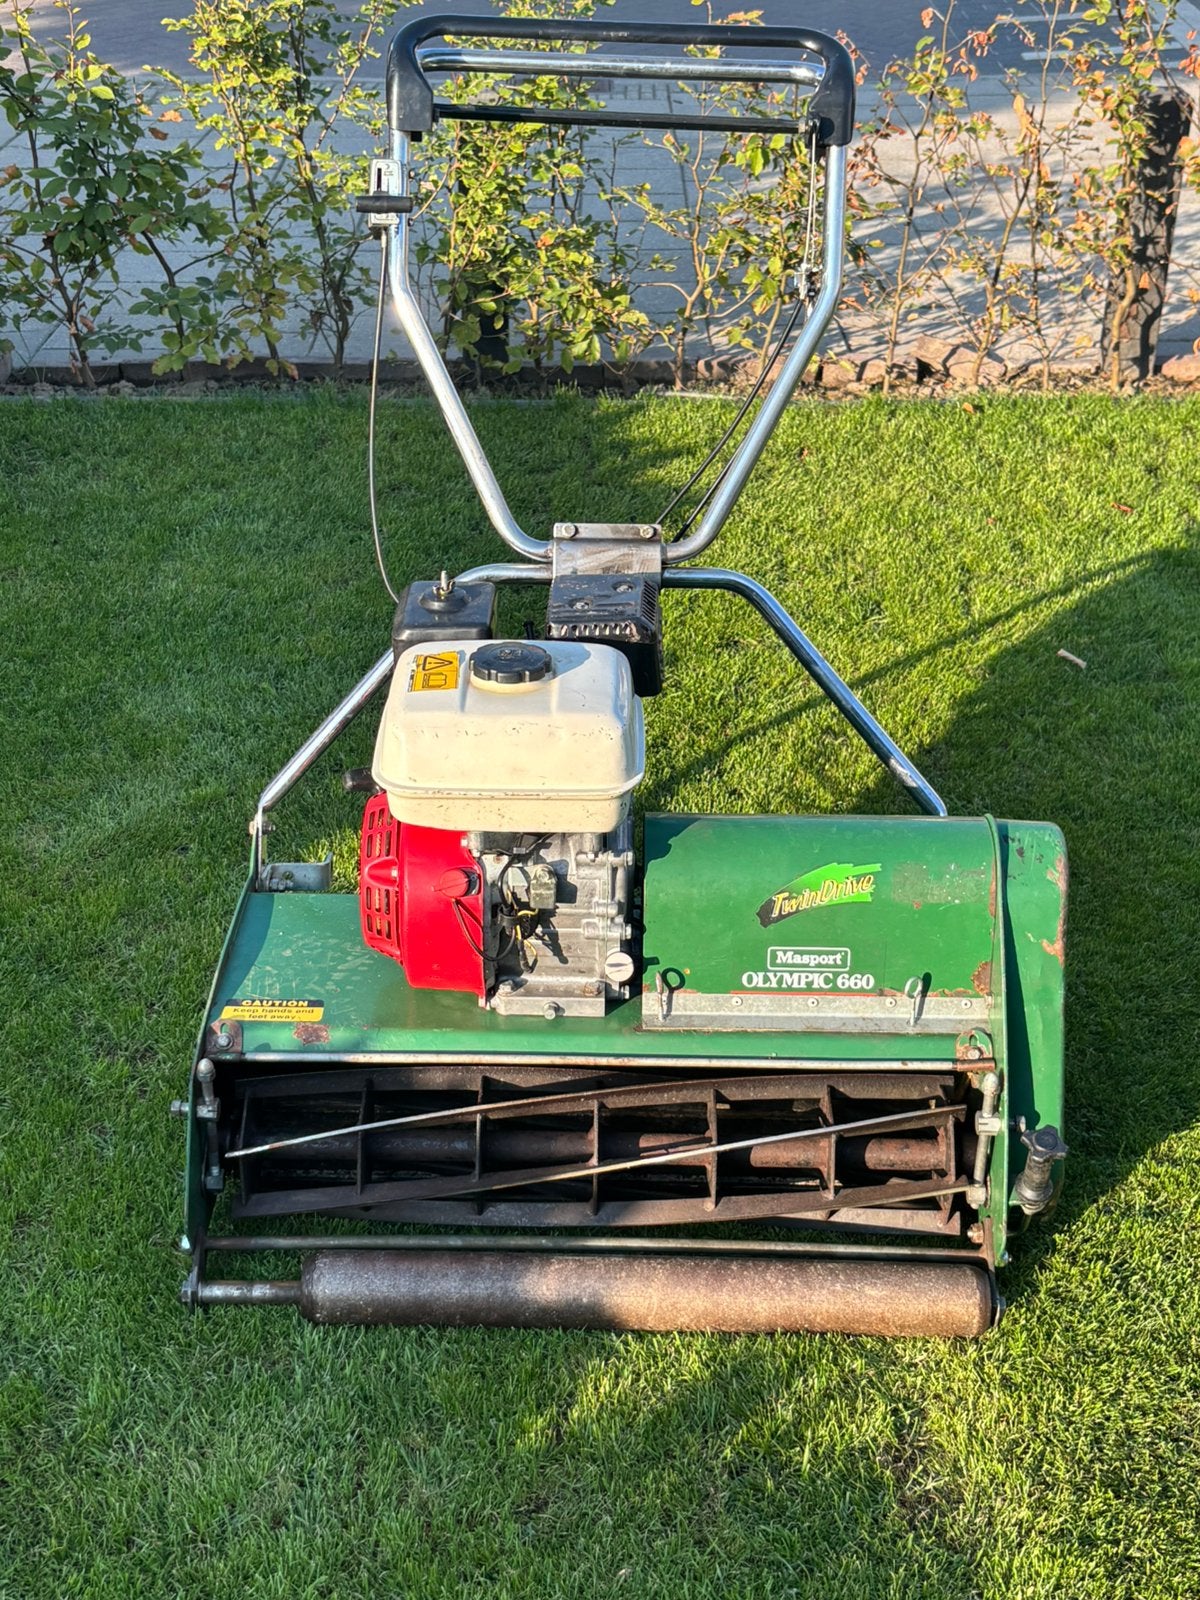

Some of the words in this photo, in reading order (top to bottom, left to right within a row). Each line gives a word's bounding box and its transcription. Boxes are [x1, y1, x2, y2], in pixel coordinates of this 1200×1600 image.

[772, 875, 874, 917] TwinDrive
[775, 951, 842, 966] Masport
[741, 971, 833, 989] OLYMPIC
[836, 973, 875, 989] 660
[241, 999, 308, 1007] CAUTION
